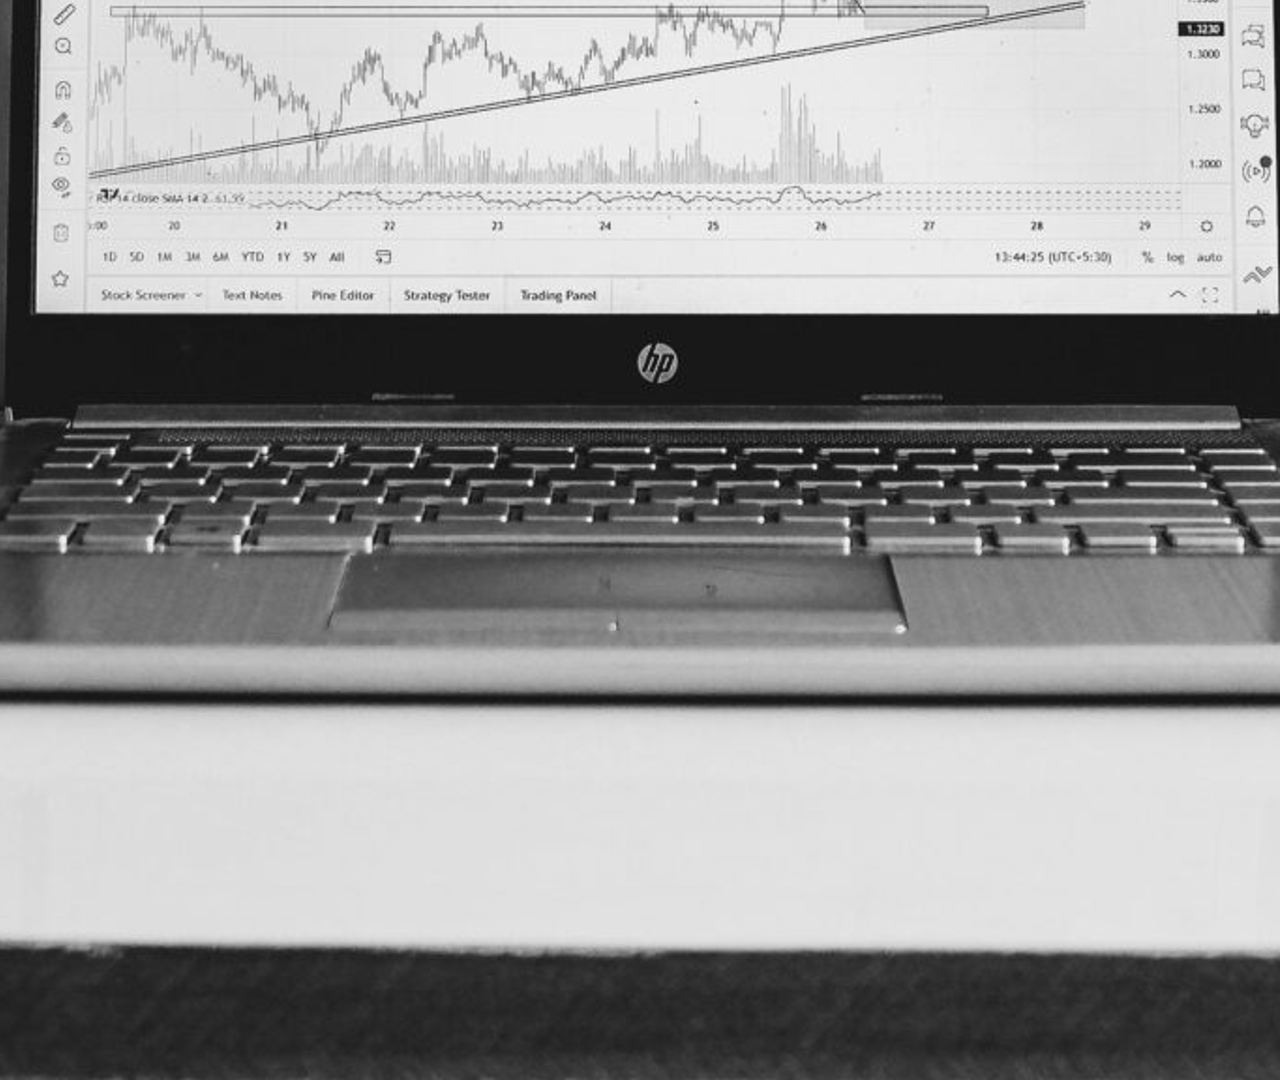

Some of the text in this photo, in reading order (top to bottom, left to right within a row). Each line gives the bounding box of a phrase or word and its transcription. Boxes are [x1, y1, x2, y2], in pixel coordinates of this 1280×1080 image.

[1188, 49, 1221, 59] 1.3000
[1189, 103, 1222, 114] 1.2500
[1189, 159, 1223, 169] 1.2000
[131, 192, 160, 204] close
[161, 193, 184, 203] SMA
[187, 194, 199, 203] 14
[168, 221, 181, 231] 20
[275, 221, 288, 231] 21
[383, 221, 396, 231] 22
[491, 221, 504, 231] 23
[599, 221, 612, 231] 24
[706, 221, 720, 231] 25
[814, 221, 828, 231] 26
[922, 221, 936, 231] 27
[1030, 221, 1044, 231] 28
[1138, 221, 1151, 231] 29
[103, 251, 117, 262] 1D
[129, 251, 145, 262] 5D
[157, 251, 172, 262] 1M
[186, 251, 201, 262] 3M
[212, 251, 230, 262] 6M
[241, 251, 265, 262] YTD
[277, 251, 291, 262] 1Y
[302, 251, 317, 262] 5Y
[328, 251, 345, 262] All
[994, 251, 1112, 264] 13:44:25 (UTC+5:30)
[1166, 251, 1185, 265] log
[1196, 252, 1223, 262] auto
[101, 289, 186, 301] Stock Screener
[222, 289, 283, 301] Text Notes
[312, 289, 375, 301] Pine Editor
[404, 289, 491, 303] Strategy Tester
[520, 289, 597, 303] Trading Panel
[638, 343, 677, 383] hp
